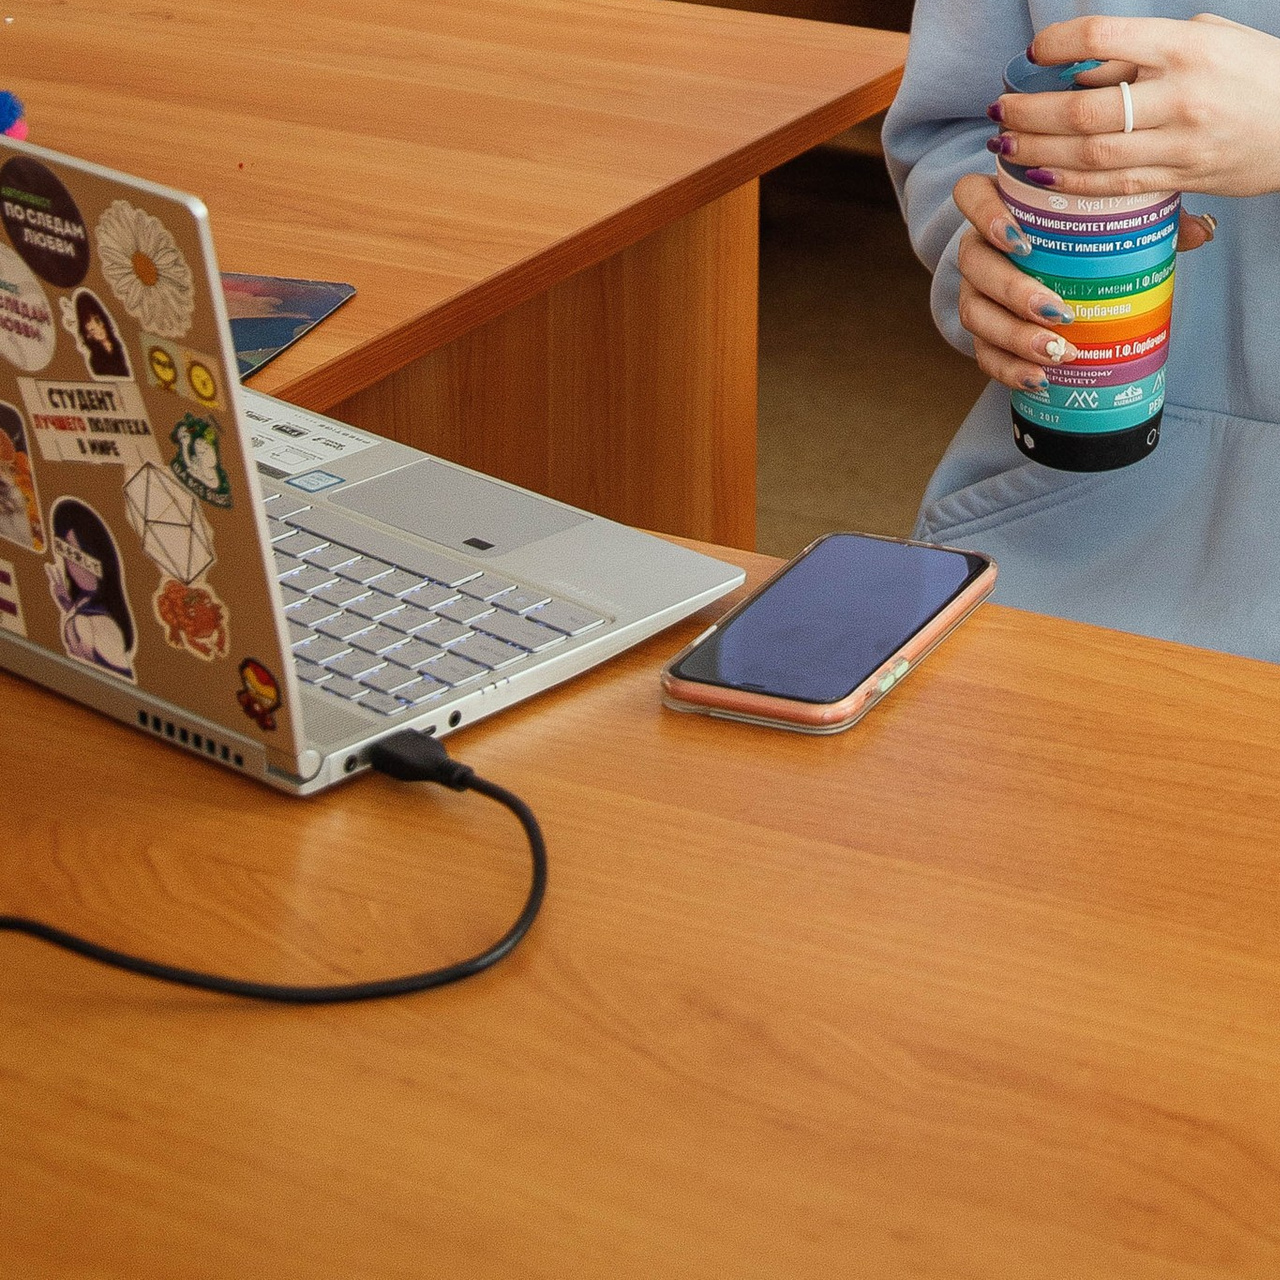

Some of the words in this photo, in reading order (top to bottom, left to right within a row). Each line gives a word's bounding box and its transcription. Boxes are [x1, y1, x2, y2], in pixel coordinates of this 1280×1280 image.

[1036, 215, 1105, 232] УНИВЕРСИТЕТ
[1106, 217, 1142, 231] ИМЕНИ
[1075, 242, 1114, 253] ИМЕНИ
[1136, 221, 1175, 247] ГОРБАЧЕВА
[1097, 280, 1133, 295] имени
[1076, 348, 1112, 359] имени
[47, 387, 117, 412] СТУДЕНТ
[1039, 412, 1060, 424] 2017
